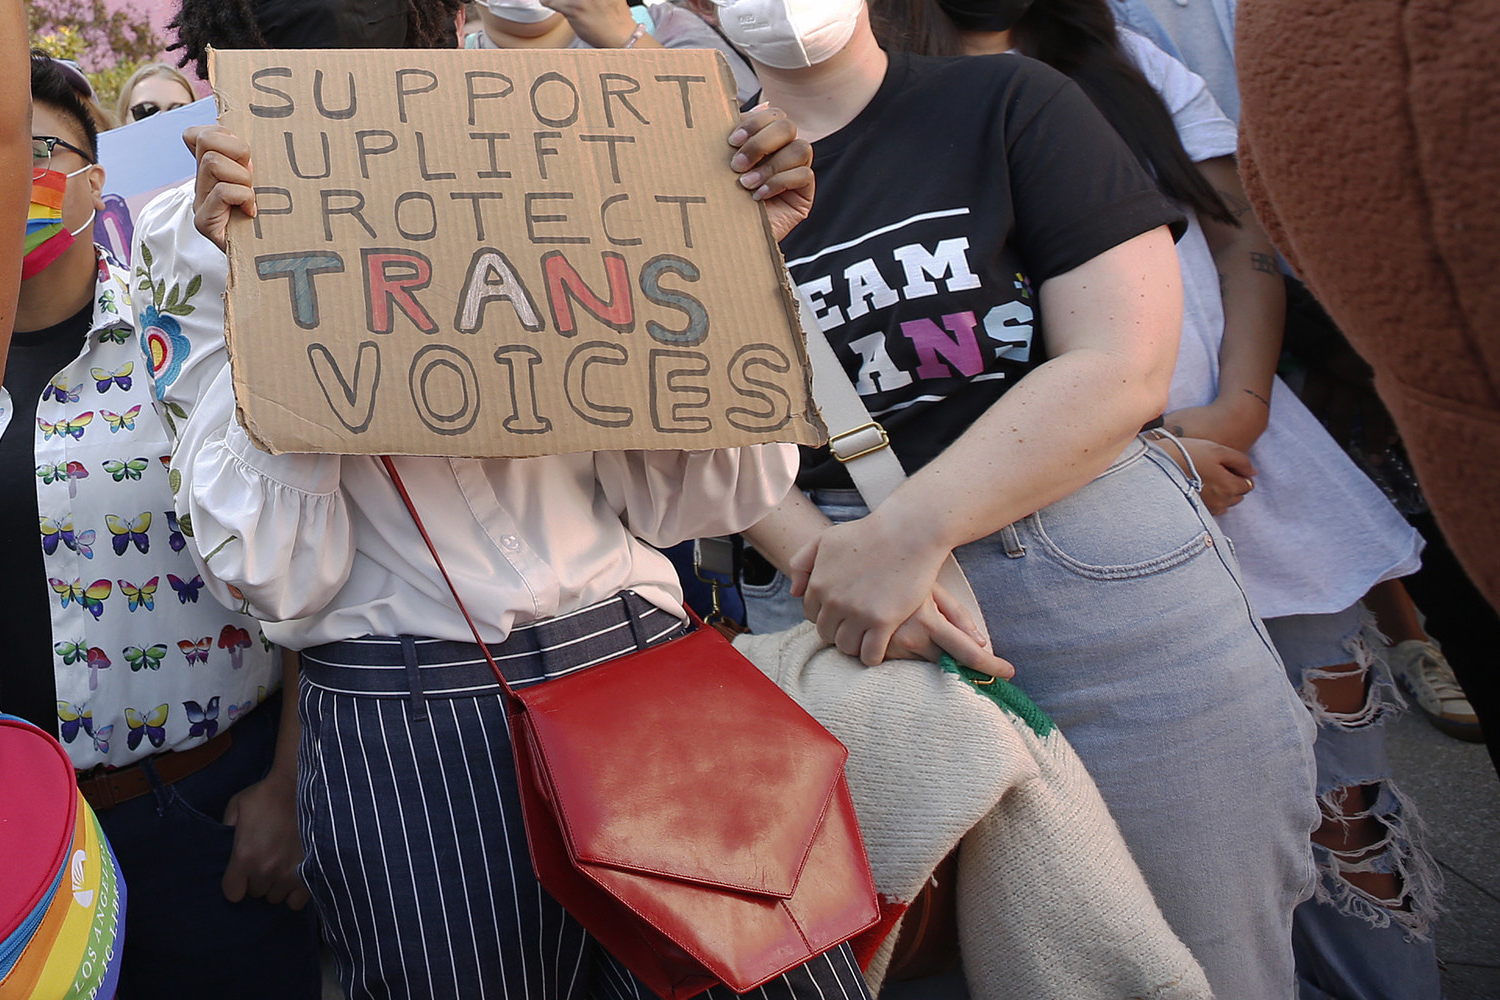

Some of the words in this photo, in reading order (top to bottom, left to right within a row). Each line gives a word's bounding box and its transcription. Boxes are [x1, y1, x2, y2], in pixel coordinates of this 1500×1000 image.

[249, 67, 706, 129] SUPPORT
[283, 129, 636, 184] UPLIFT
[252, 188, 707, 248] PROTECT
[254, 247, 711, 348] TRANS
[796, 236, 982, 333] EAM
[848, 300, 1034, 396] ANS
[306, 339, 793, 436] VOICES
[75, 946, 97, 994] LOS
[87, 944, 114, 1000] BLIC
